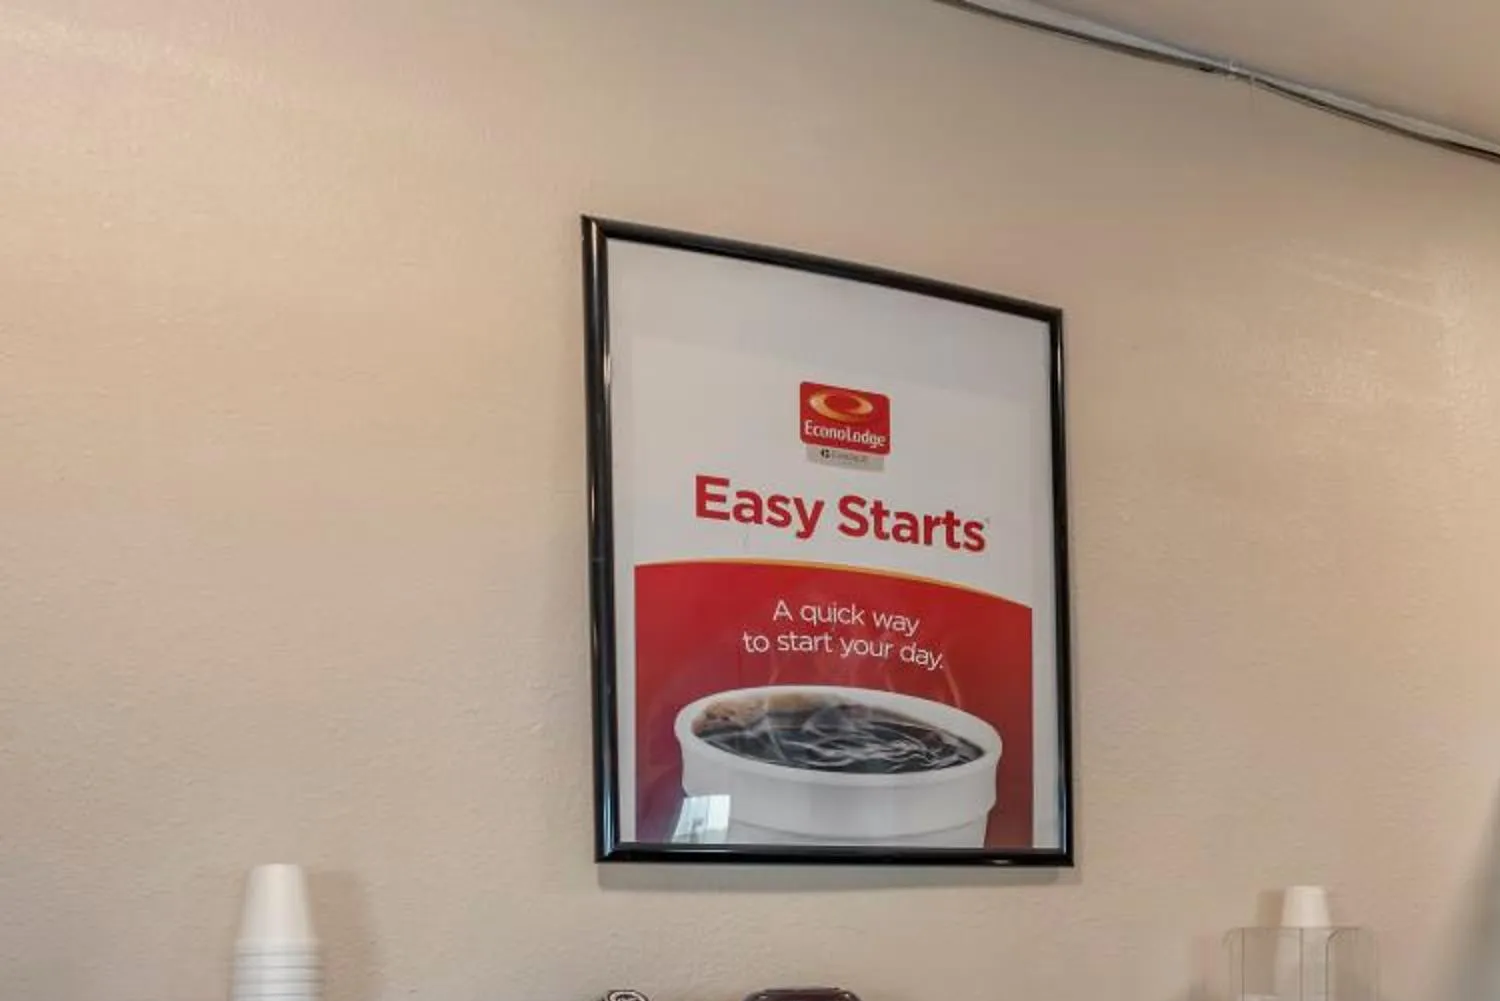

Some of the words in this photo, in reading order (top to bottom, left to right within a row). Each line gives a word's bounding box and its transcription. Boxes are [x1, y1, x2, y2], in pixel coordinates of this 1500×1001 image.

[696, 474, 825, 539] Easy
[837, 495, 986, 552] Starts
[772, 600, 793, 621] A
[800, 602, 865, 627] quick
[873, 610, 921, 637] way
[743, 631, 770, 653] to
[777, 631, 833, 653] start
[839, 638, 894, 659] your
[900, 642, 944, 669] day.
